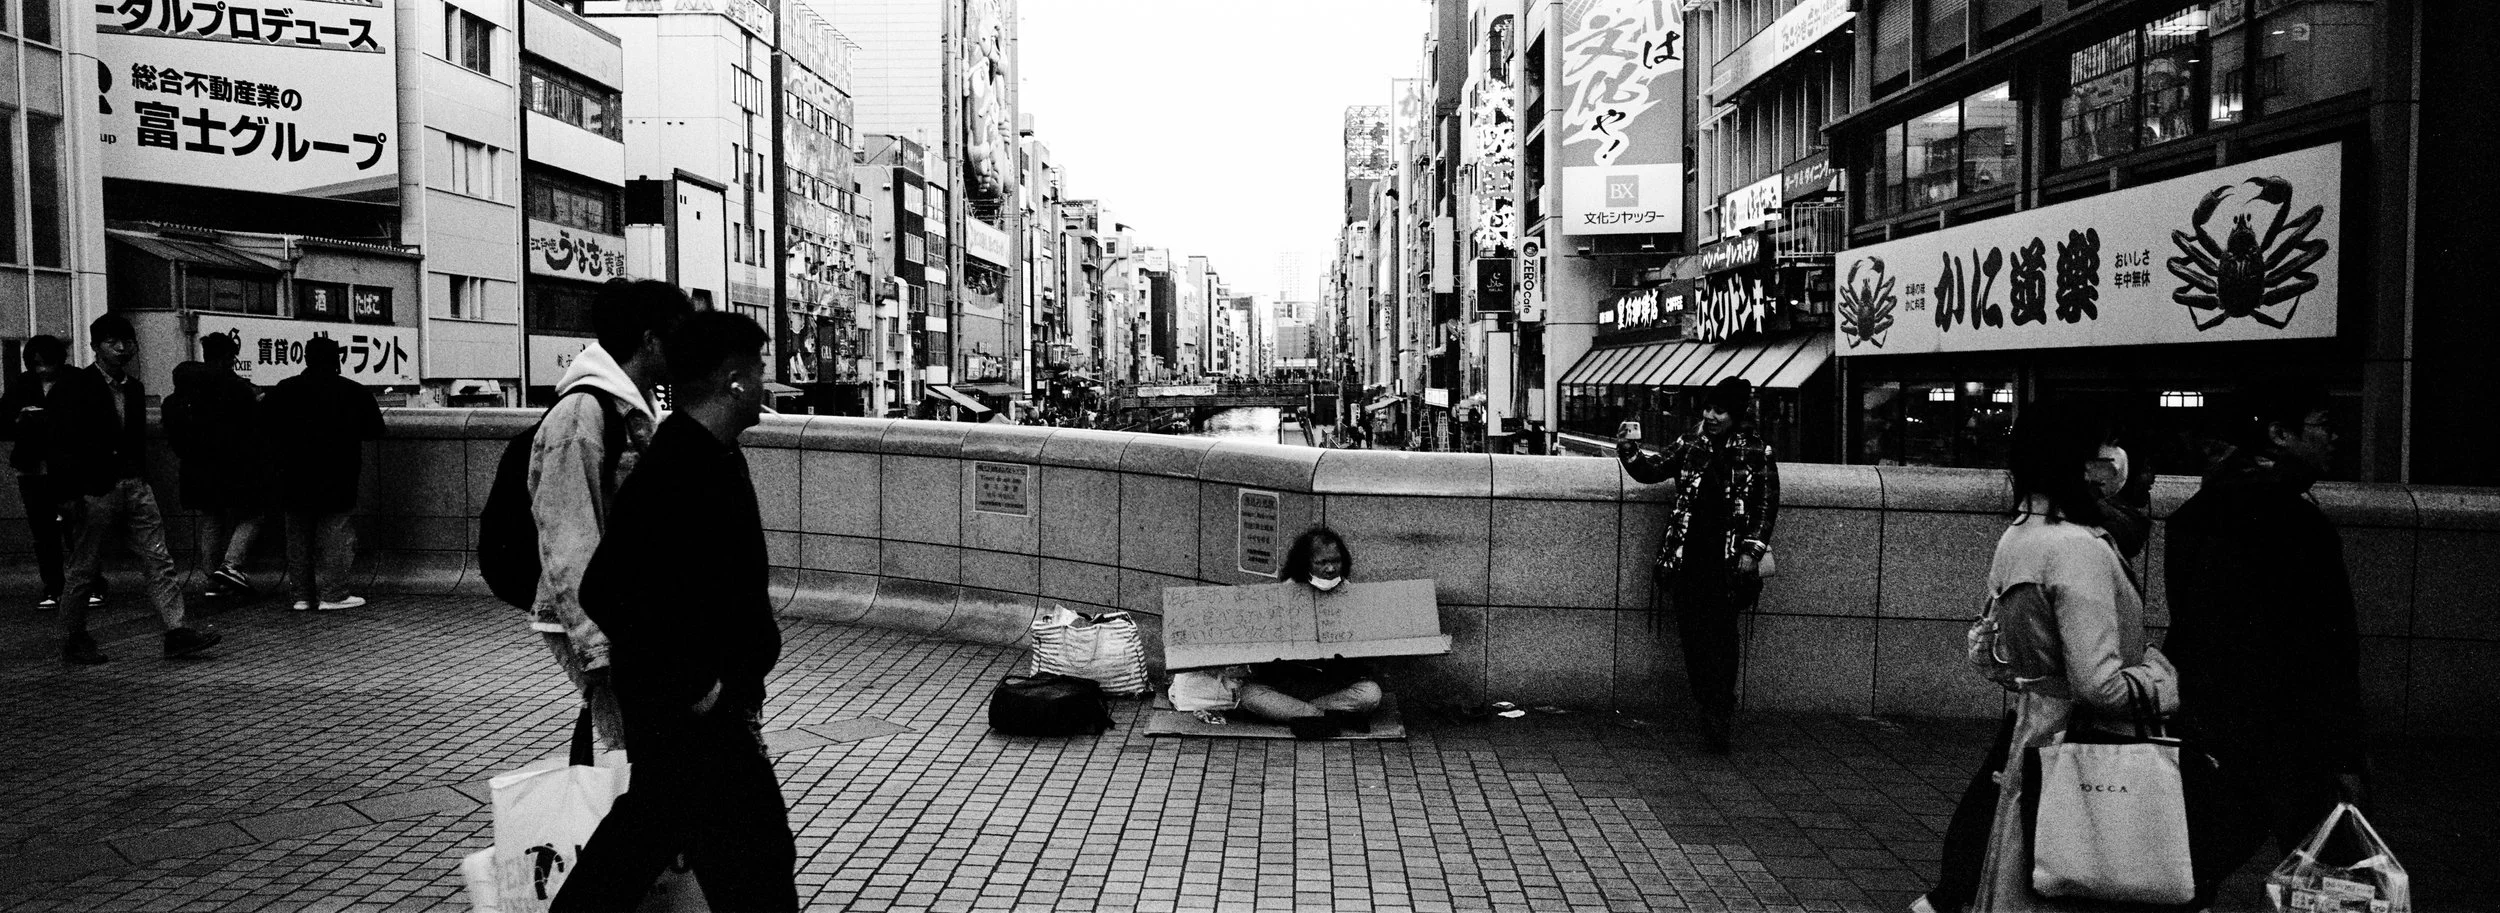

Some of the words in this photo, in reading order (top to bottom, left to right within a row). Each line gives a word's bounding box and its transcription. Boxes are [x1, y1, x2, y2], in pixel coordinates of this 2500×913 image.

[131, 63, 303, 111] 総合不動産業の
[134, 101, 387, 171] 富士グループ
[1610, 183, 1635, 199] BX
[1702, 237, 1760, 269] ハンバーグレストラン
[2114, 249, 2151, 269] おいしさ
[1523, 259, 1535, 291] ZERO
[1934, 227, 2101, 333] かに道楽
[2113, 270, 2151, 289] 年中無休
[314, 289, 328, 312] 酒
[355, 294, 381, 316] たばこ
[1665, 294, 1684, 313] COFFEE
[1694, 272, 1777, 343] びっくりドンキー
[257, 338, 304, 366] 賃貸の
[2079, 783, 2129, 793] TOCCA
